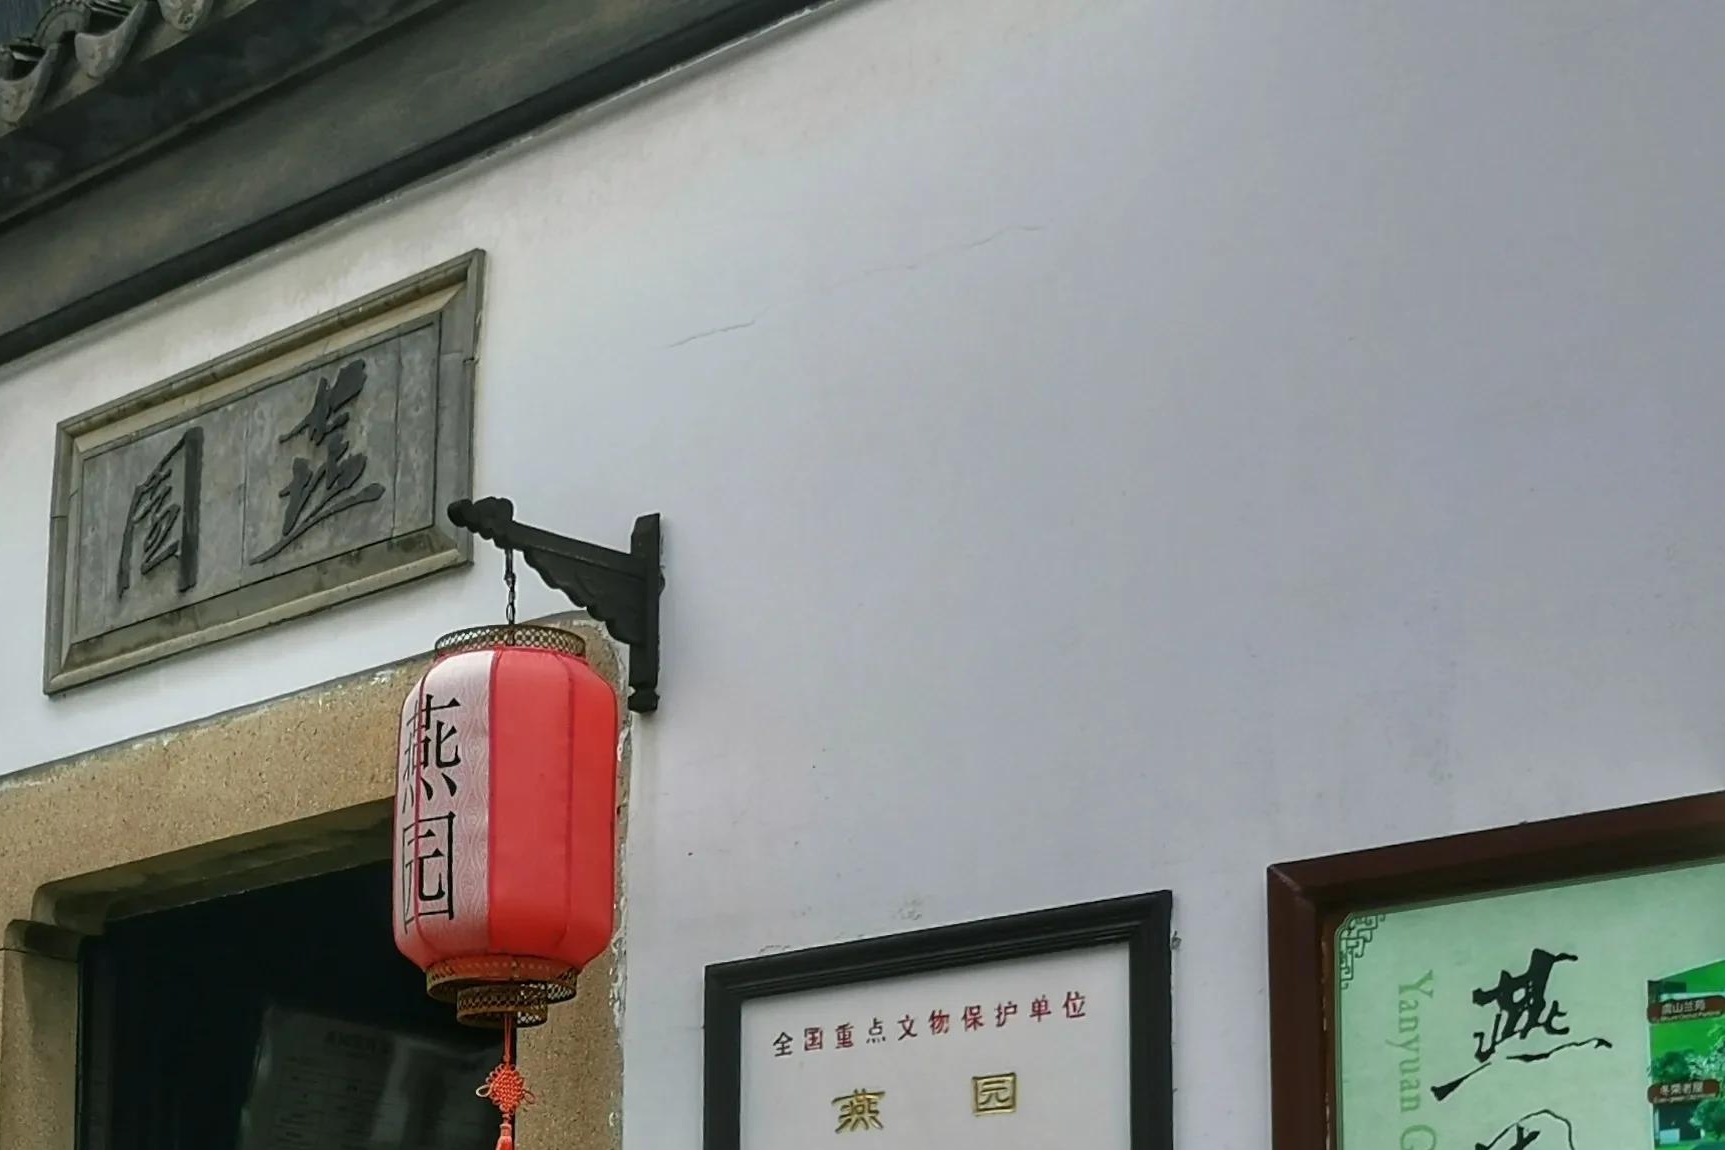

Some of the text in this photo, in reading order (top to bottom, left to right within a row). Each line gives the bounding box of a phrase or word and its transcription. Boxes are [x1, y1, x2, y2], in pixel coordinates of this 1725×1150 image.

[772, 990, 1088, 1058] 全国重点文物保护单位
[1385, 969, 1435, 1113] Yanyuan
[830, 1071, 1018, 1134] 燕园
